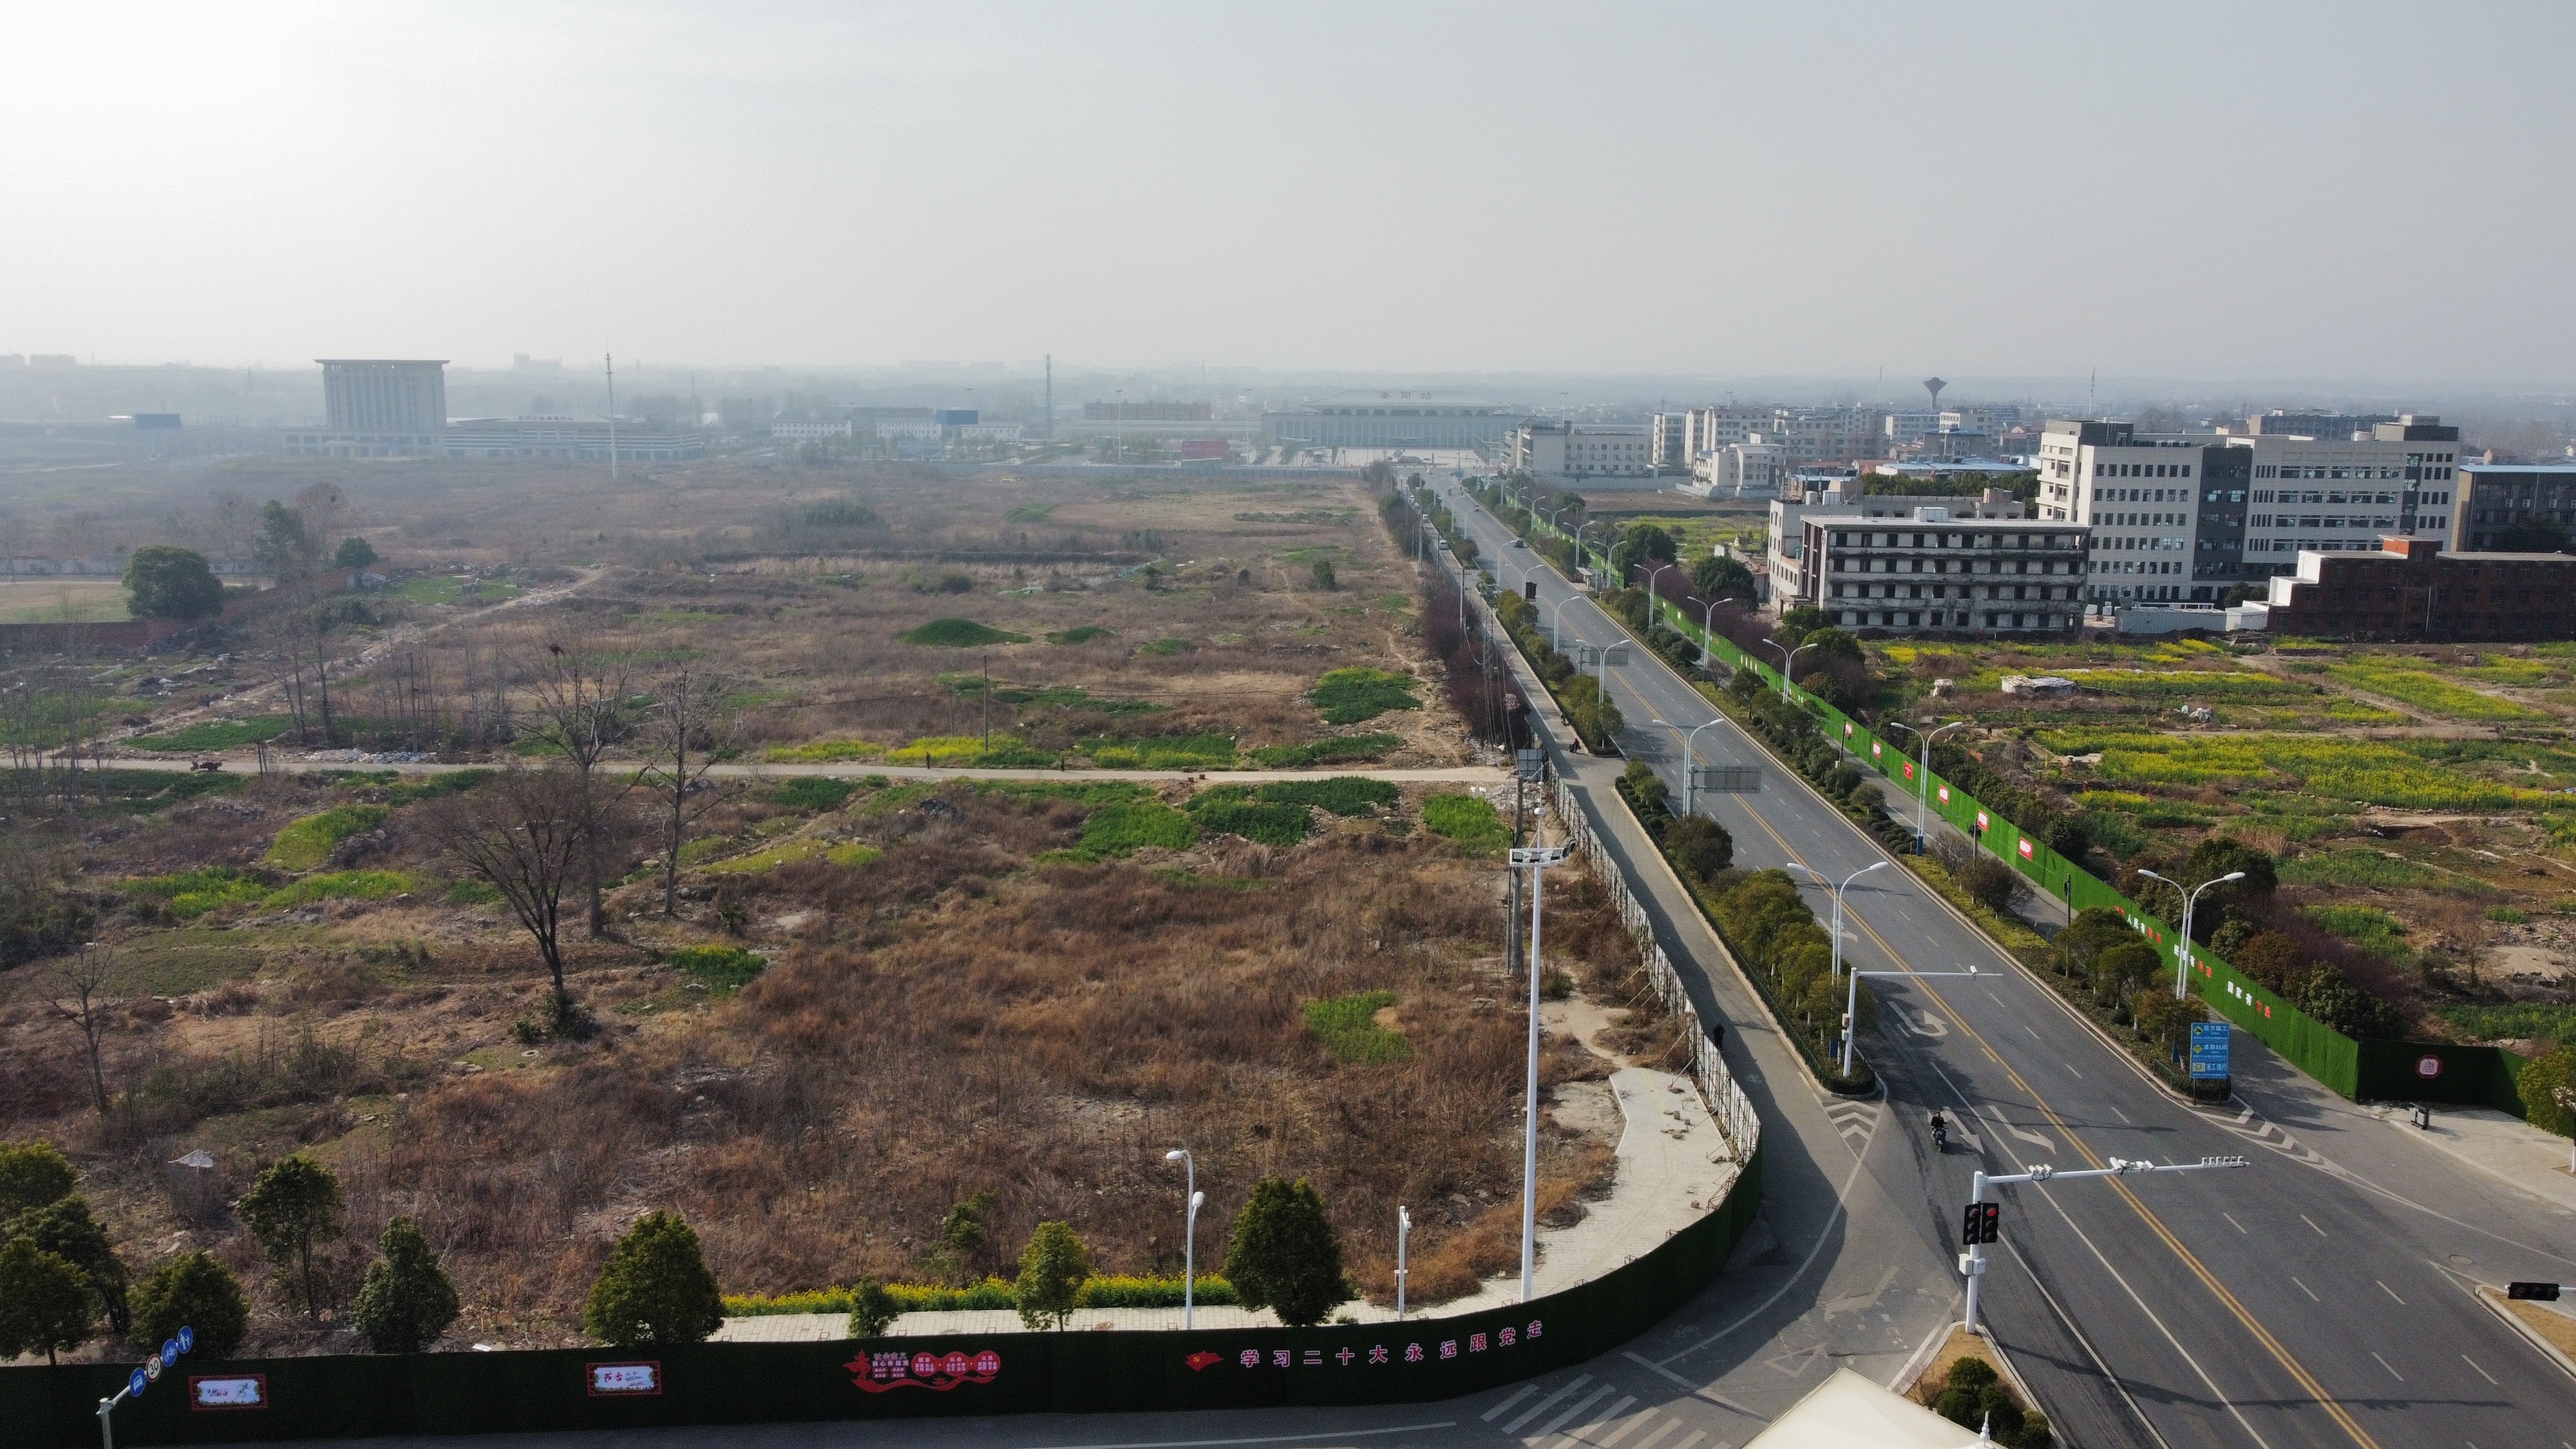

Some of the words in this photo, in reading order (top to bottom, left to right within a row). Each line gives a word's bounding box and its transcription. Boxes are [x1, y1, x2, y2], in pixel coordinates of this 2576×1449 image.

[1380, 391, 1432, 400] 枣阳站
[1240, 1320, 1542, 1367] 学习二十大永远跟党走
[149, 1359, 159, 1375] 30
